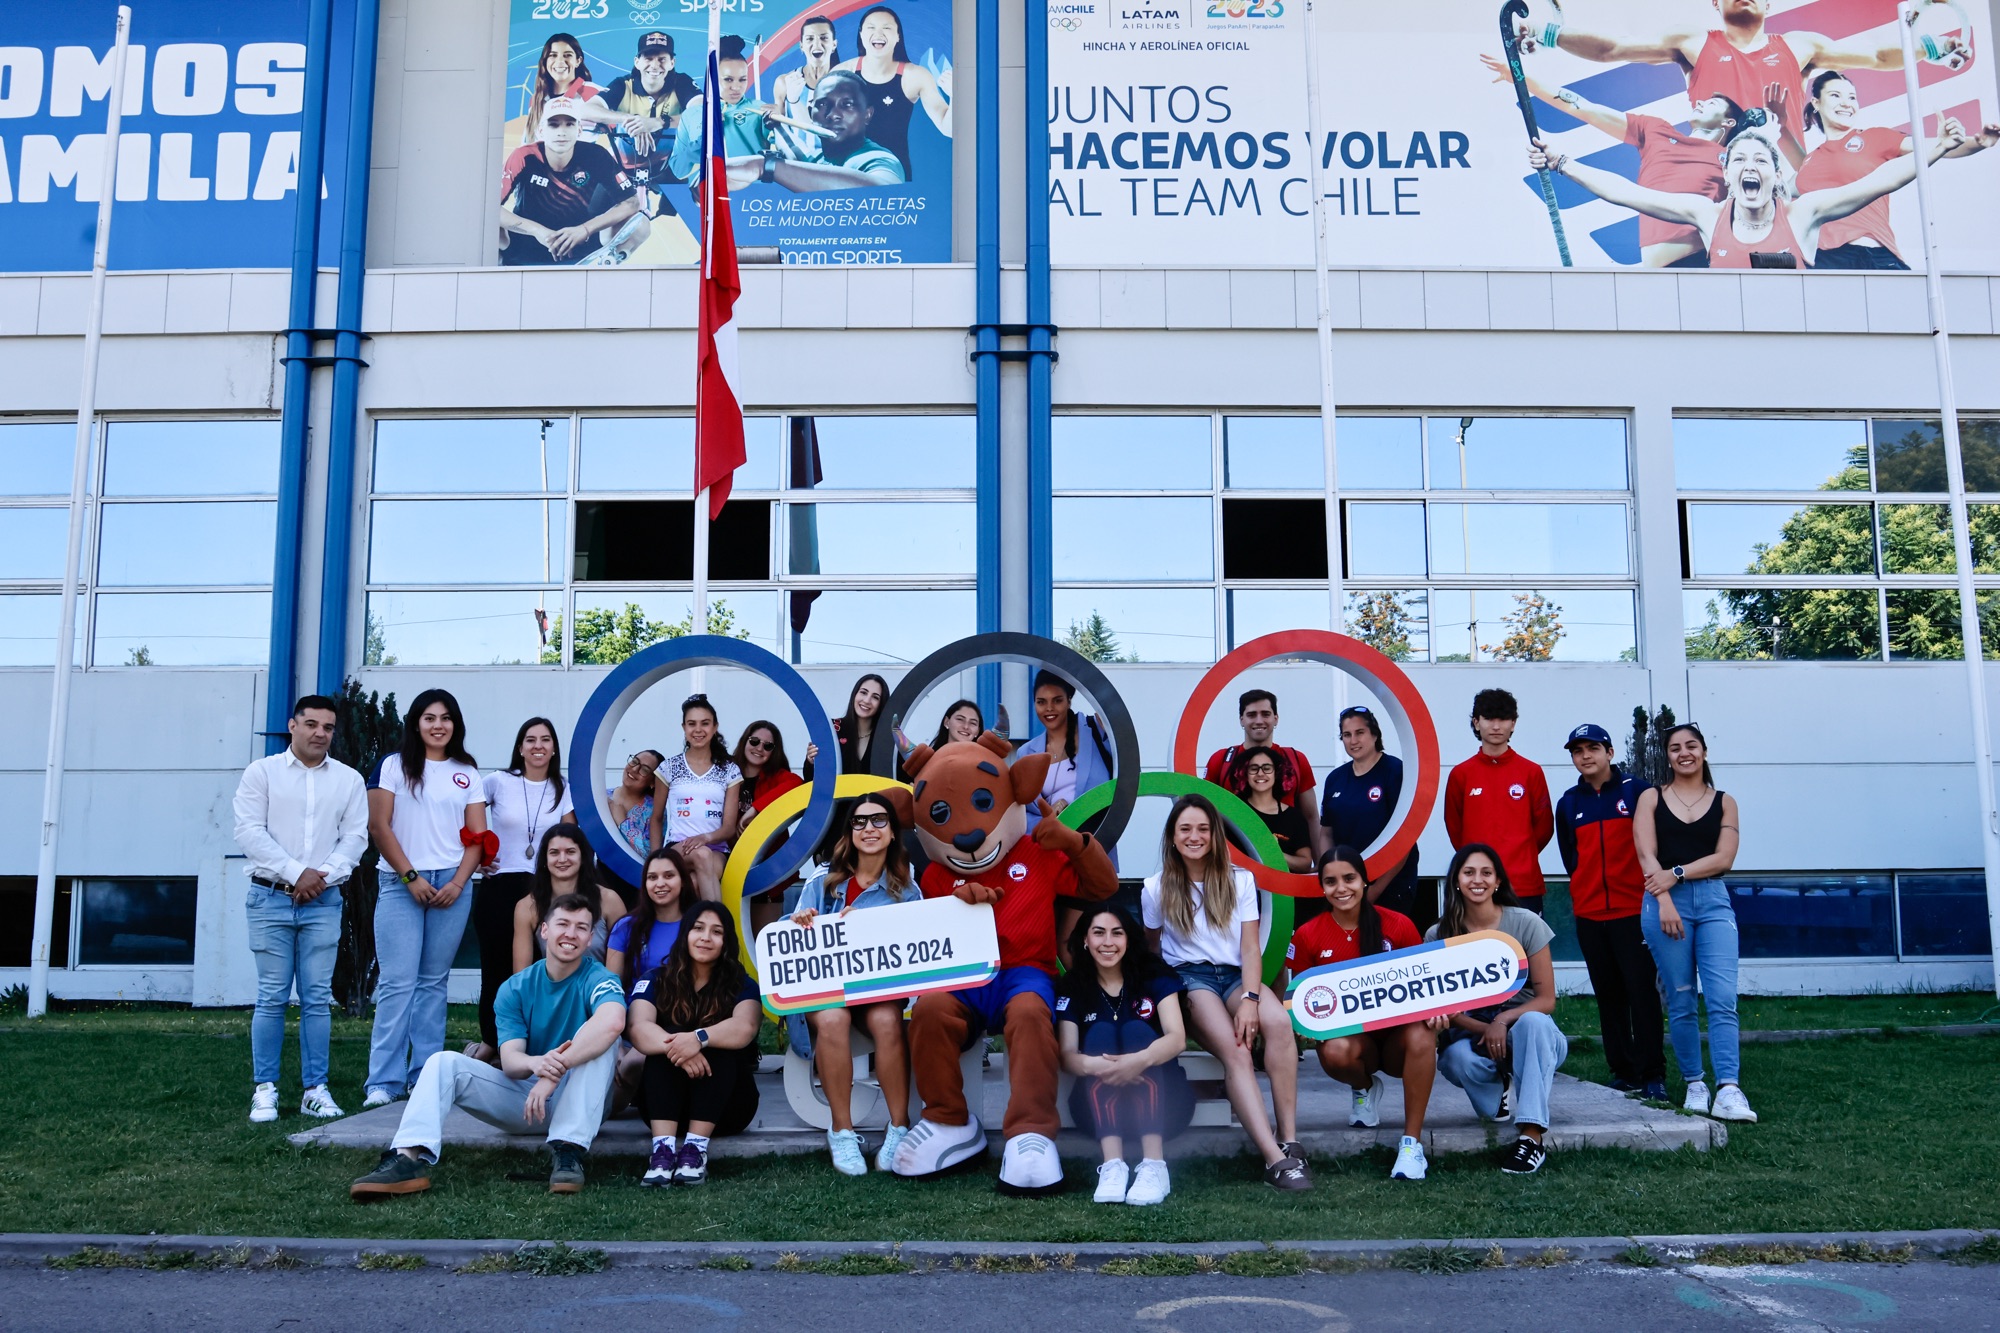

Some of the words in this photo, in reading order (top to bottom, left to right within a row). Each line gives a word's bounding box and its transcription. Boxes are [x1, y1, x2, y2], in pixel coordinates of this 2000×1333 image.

[531, 0, 609, 20] 2023
[680, 0, 764, 13] SPRTS
[1122, 10, 1180, 20] LATAM
[1207, 0, 1285, 18] 2023
[1207, 23, 1227, 31] Juegos
[1252, 23, 1285, 31] ParapanAm
[1083, 41, 1126, 51] HINCHA
[1129, 41, 1137, 51] Y
[1140, 39, 1203, 51] AEROLÍNEA
[1206, 41, 1250, 51] OFICIAL
[1049, 85, 1232, 124] JUNTOS
[1049, 131, 1292, 170] HACEMOS
[1305, 130, 1472, 170] VOLAR
[530, 174, 550, 188] PER
[741, 199, 773, 212] LOS
[776, 198, 854, 212] MEJORES
[857, 197, 926, 211] ATLETAS
[1049, 178, 1102, 217] AL
[1120, 178, 1262, 217] TEAM
[1279, 177, 1421, 217] CHILE
[748, 215, 775, 227] DEL
[778, 215, 836, 227] MUNDO
[839, 215, 858, 226] EN
[860, 211, 918, 226] ACCIÓN
[778, 237, 839, 246] TOTALMENTE
[839, 237, 873, 245] GRATIS
[874, 236, 887, 244] EN
[832, 249, 903, 264] SPORTS
[766, 926, 817, 957] FORO
[821, 921, 848, 949] DE
[769, 943, 902, 987] DEPORTISTAS
[906, 937, 954, 965] 2024
[1338, 966, 1409, 992] COMISIÓN
[1412, 962, 1431, 975] DE
[1340, 963, 1501, 1015] DEPORTISTAS
